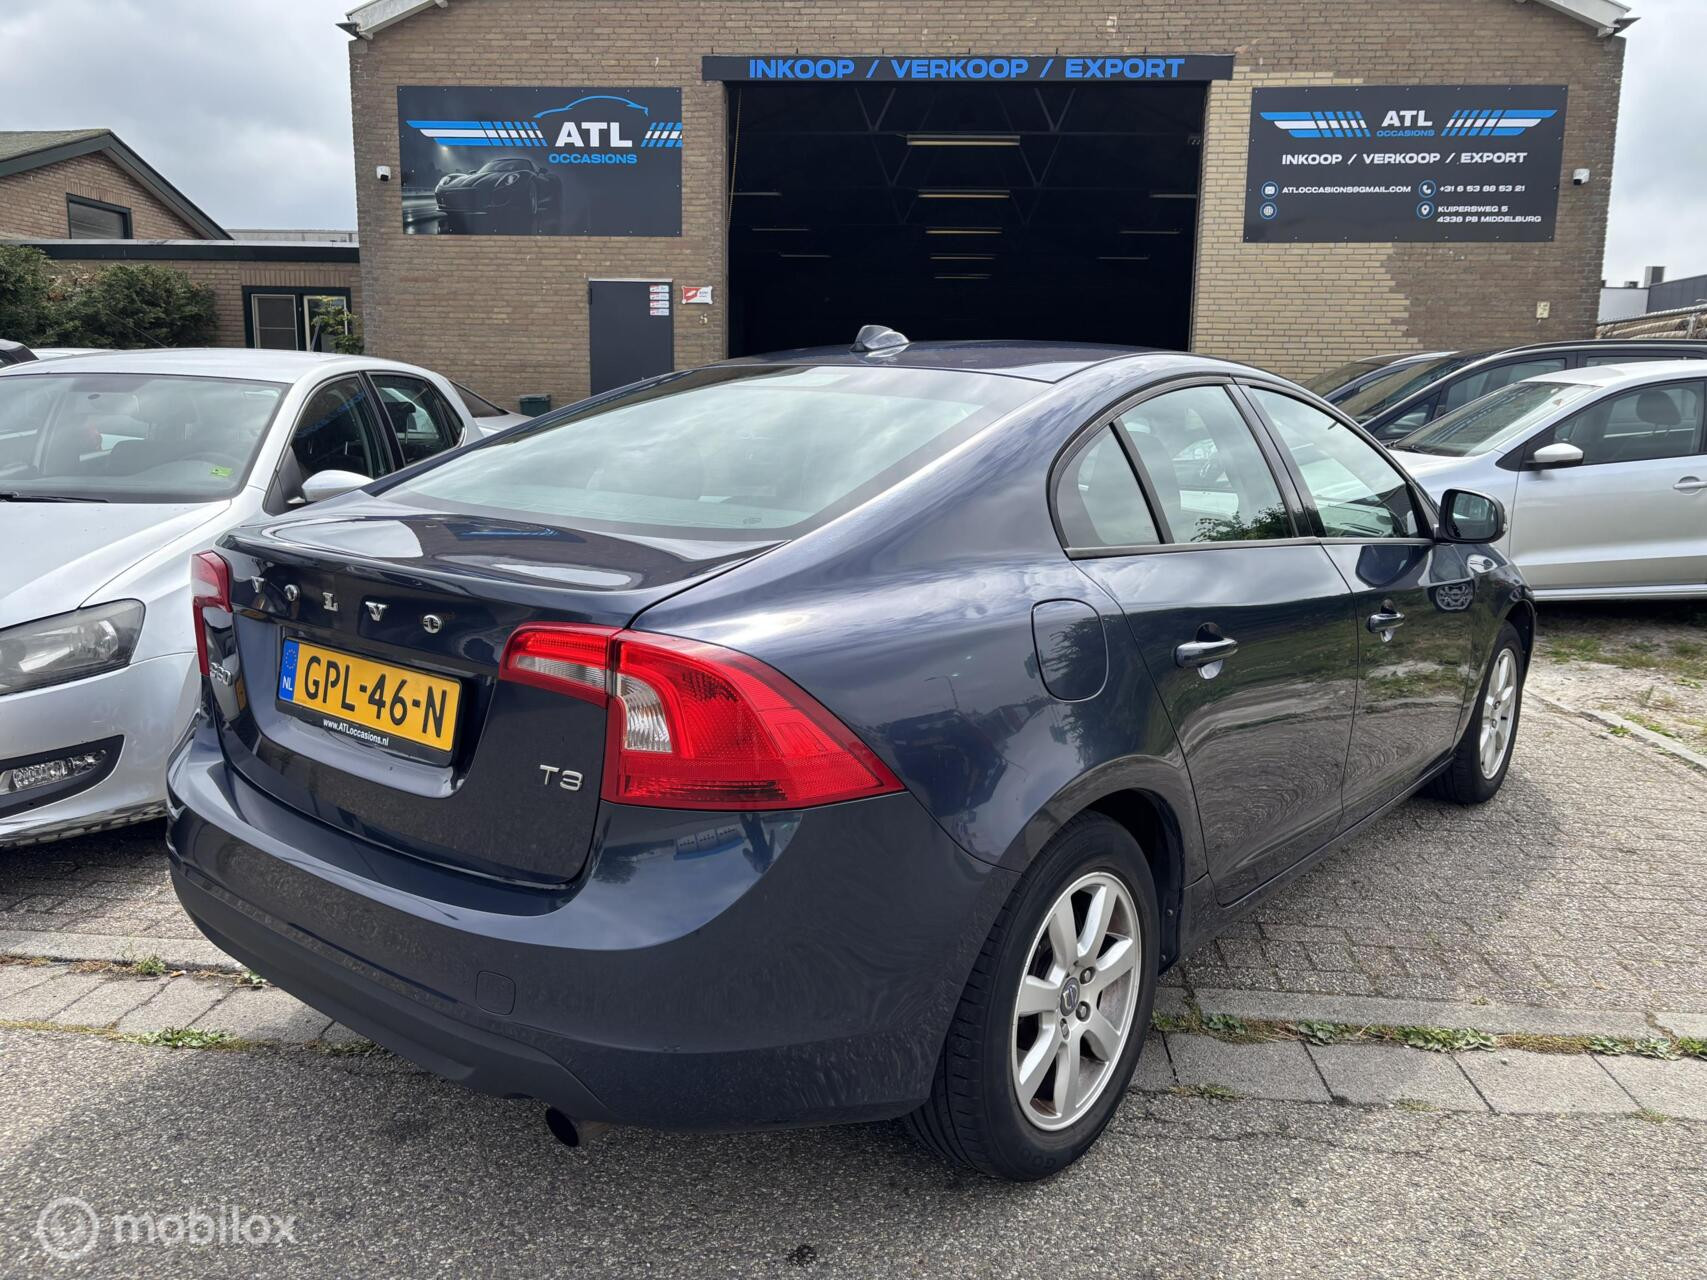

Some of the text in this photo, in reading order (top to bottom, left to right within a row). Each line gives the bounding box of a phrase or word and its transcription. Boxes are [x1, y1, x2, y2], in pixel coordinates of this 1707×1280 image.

[749, 58, 1185, 78] INKOOP / VERKOOP / EXPORT
[1381, 110, 1432, 127] ATL
[555, 121, 632, 147] ATL
[1376, 129, 1435, 137] OCCASIONS
[549, 153, 637, 164] OCCASIONS
[1281, 152, 1528, 165] INKOOP / VERKOOP / EXPORT
[1480, 215, 1542, 223] MIDDELBURG
[250, 576, 443, 634] VOLVO
[282, 675, 294, 692] NL
[304, 655, 448, 739] GPL-46-N
[323, 719, 389, 746] www.ATLoccasions.nl
[539, 764, 585, 791] T3
